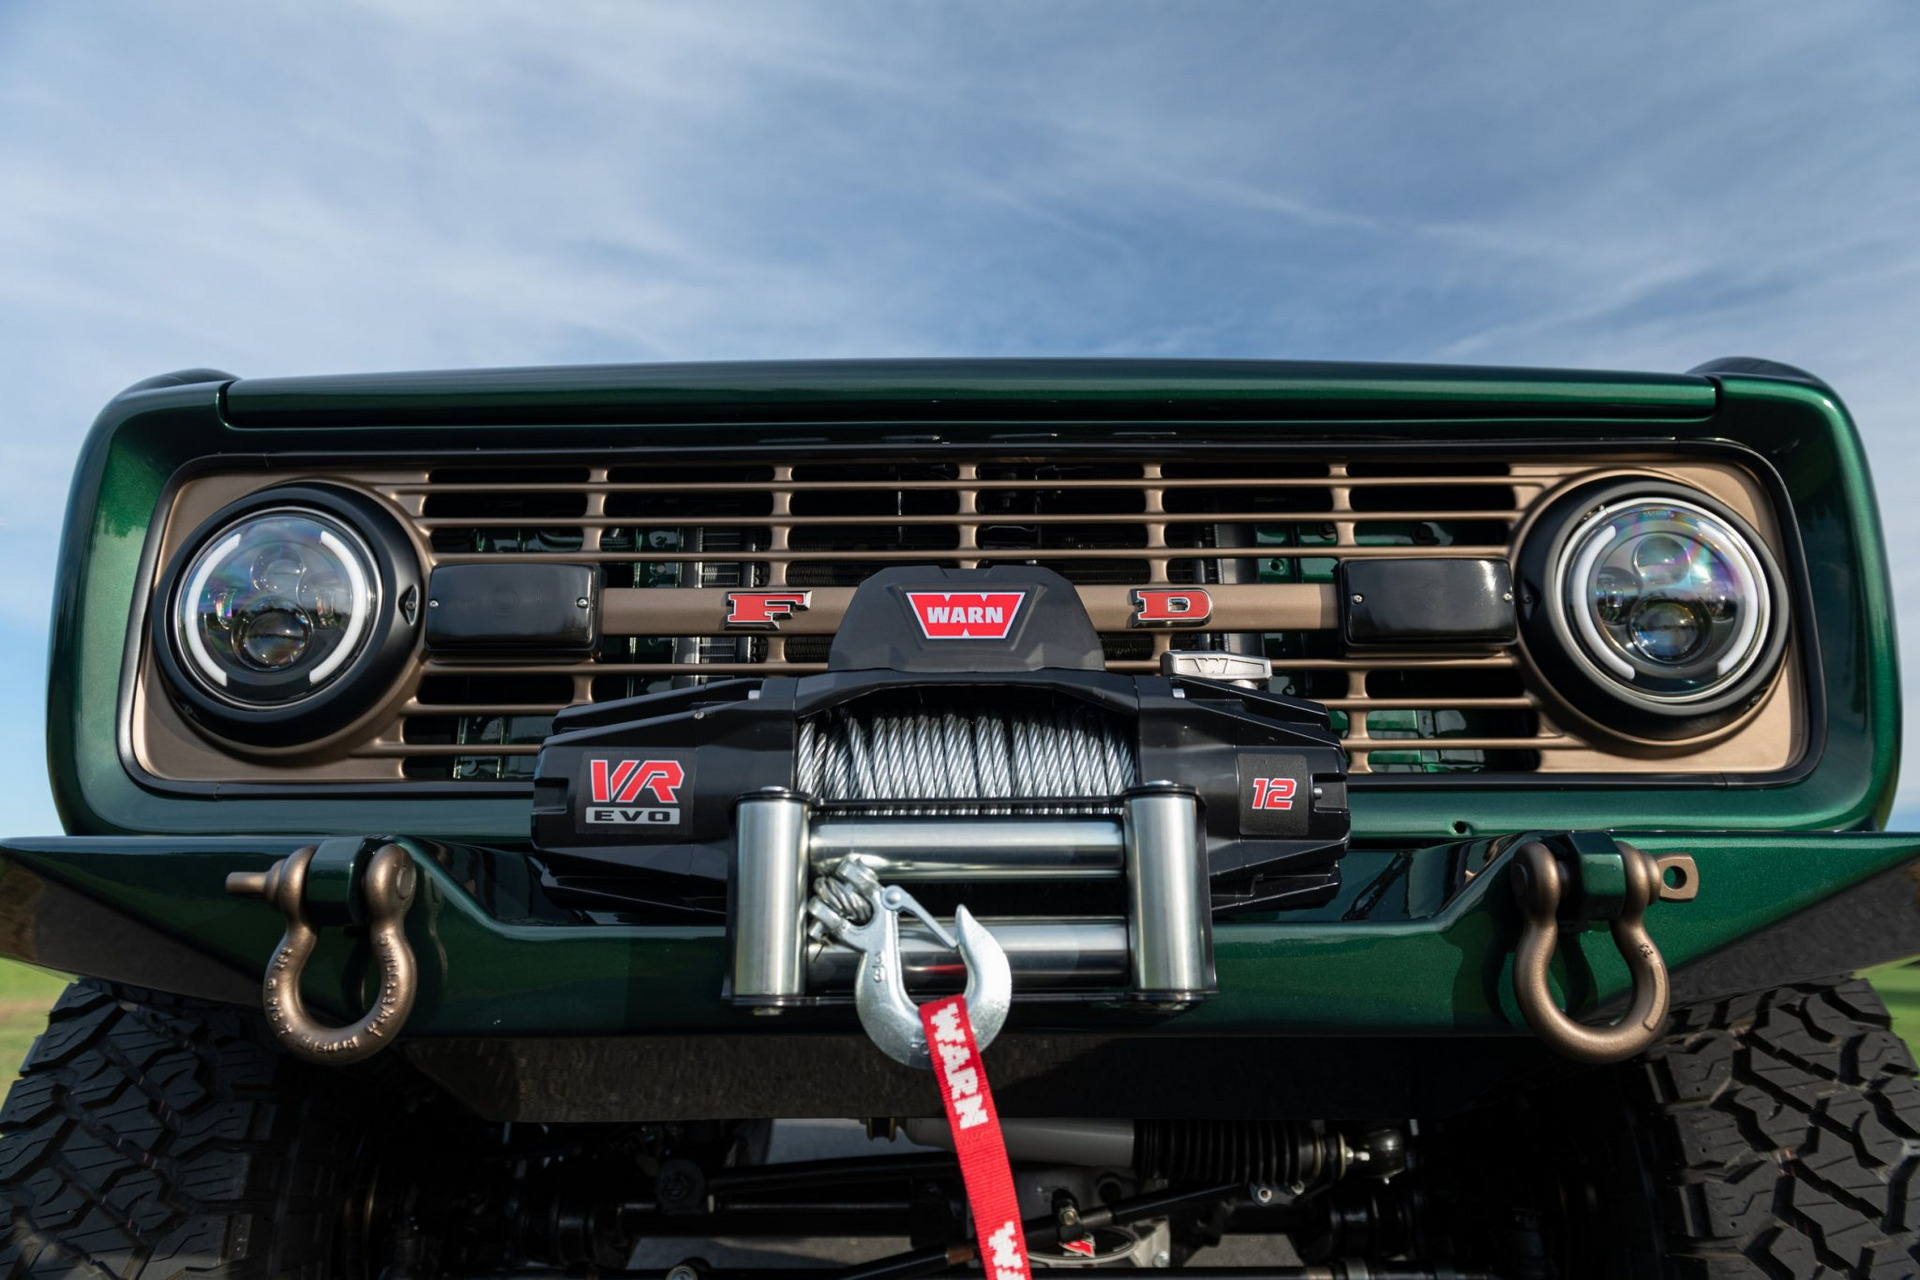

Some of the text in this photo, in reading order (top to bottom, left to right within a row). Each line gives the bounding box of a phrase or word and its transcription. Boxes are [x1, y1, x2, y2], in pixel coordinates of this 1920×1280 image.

[926, 606, 1004, 624] WARN
[590, 759, 685, 803] VR
[1251, 777, 1297, 810] 12
[594, 809, 671, 822] EVO
[930, 1002, 989, 1130] WARN
